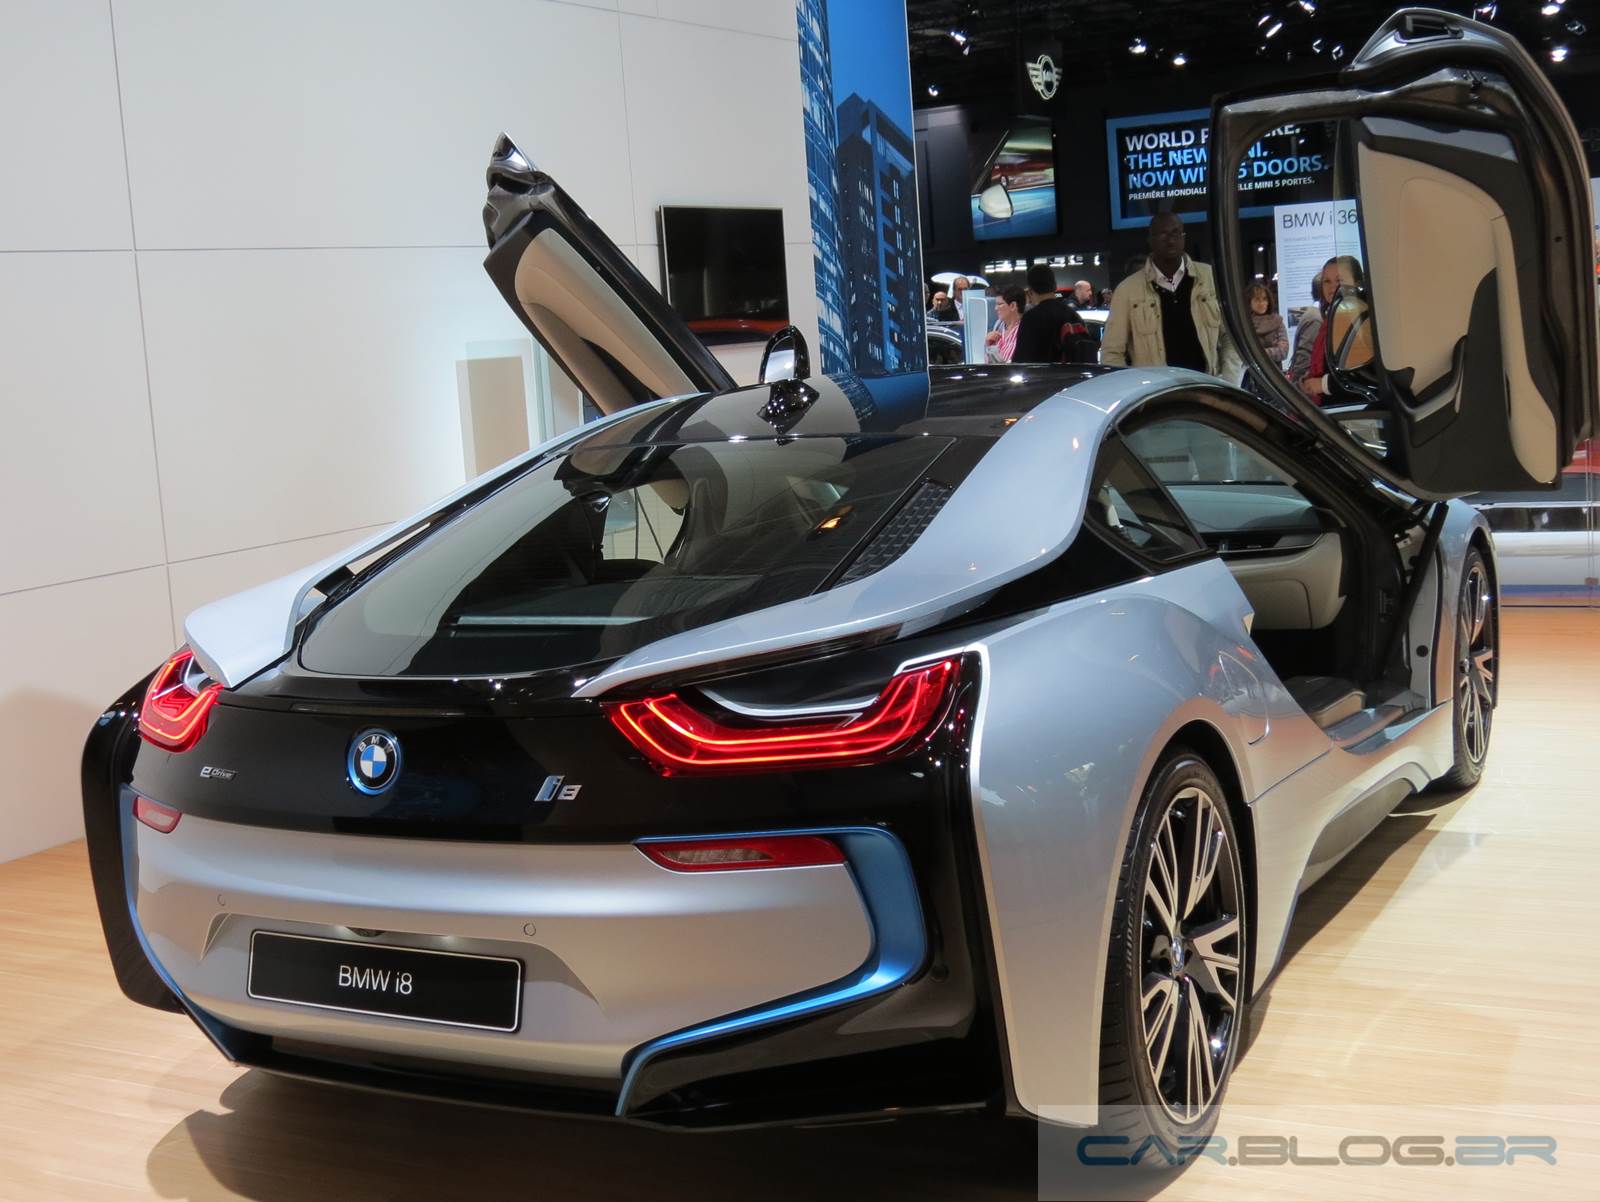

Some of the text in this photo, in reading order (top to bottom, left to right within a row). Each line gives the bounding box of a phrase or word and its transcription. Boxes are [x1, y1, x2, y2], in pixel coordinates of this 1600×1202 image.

[1125, 130, 1195, 152] WORLD
[1126, 147, 1207, 170] THE NEW
[1128, 170, 1175, 189] NOW
[1180, 166, 1207, 184] WI
[1253, 155, 1329, 178] DOORS.
[1167, 187, 1207, 197] MONDIALE
[1254, 180, 1273, 189] MINI
[1275, 179, 1280, 188] 5
[1281, 176, 1315, 187] PORTES.
[1282, 211, 1325, 229] BMW
[534, 775, 582, 801] i8
[338, 965, 413, 995] BMW i8
